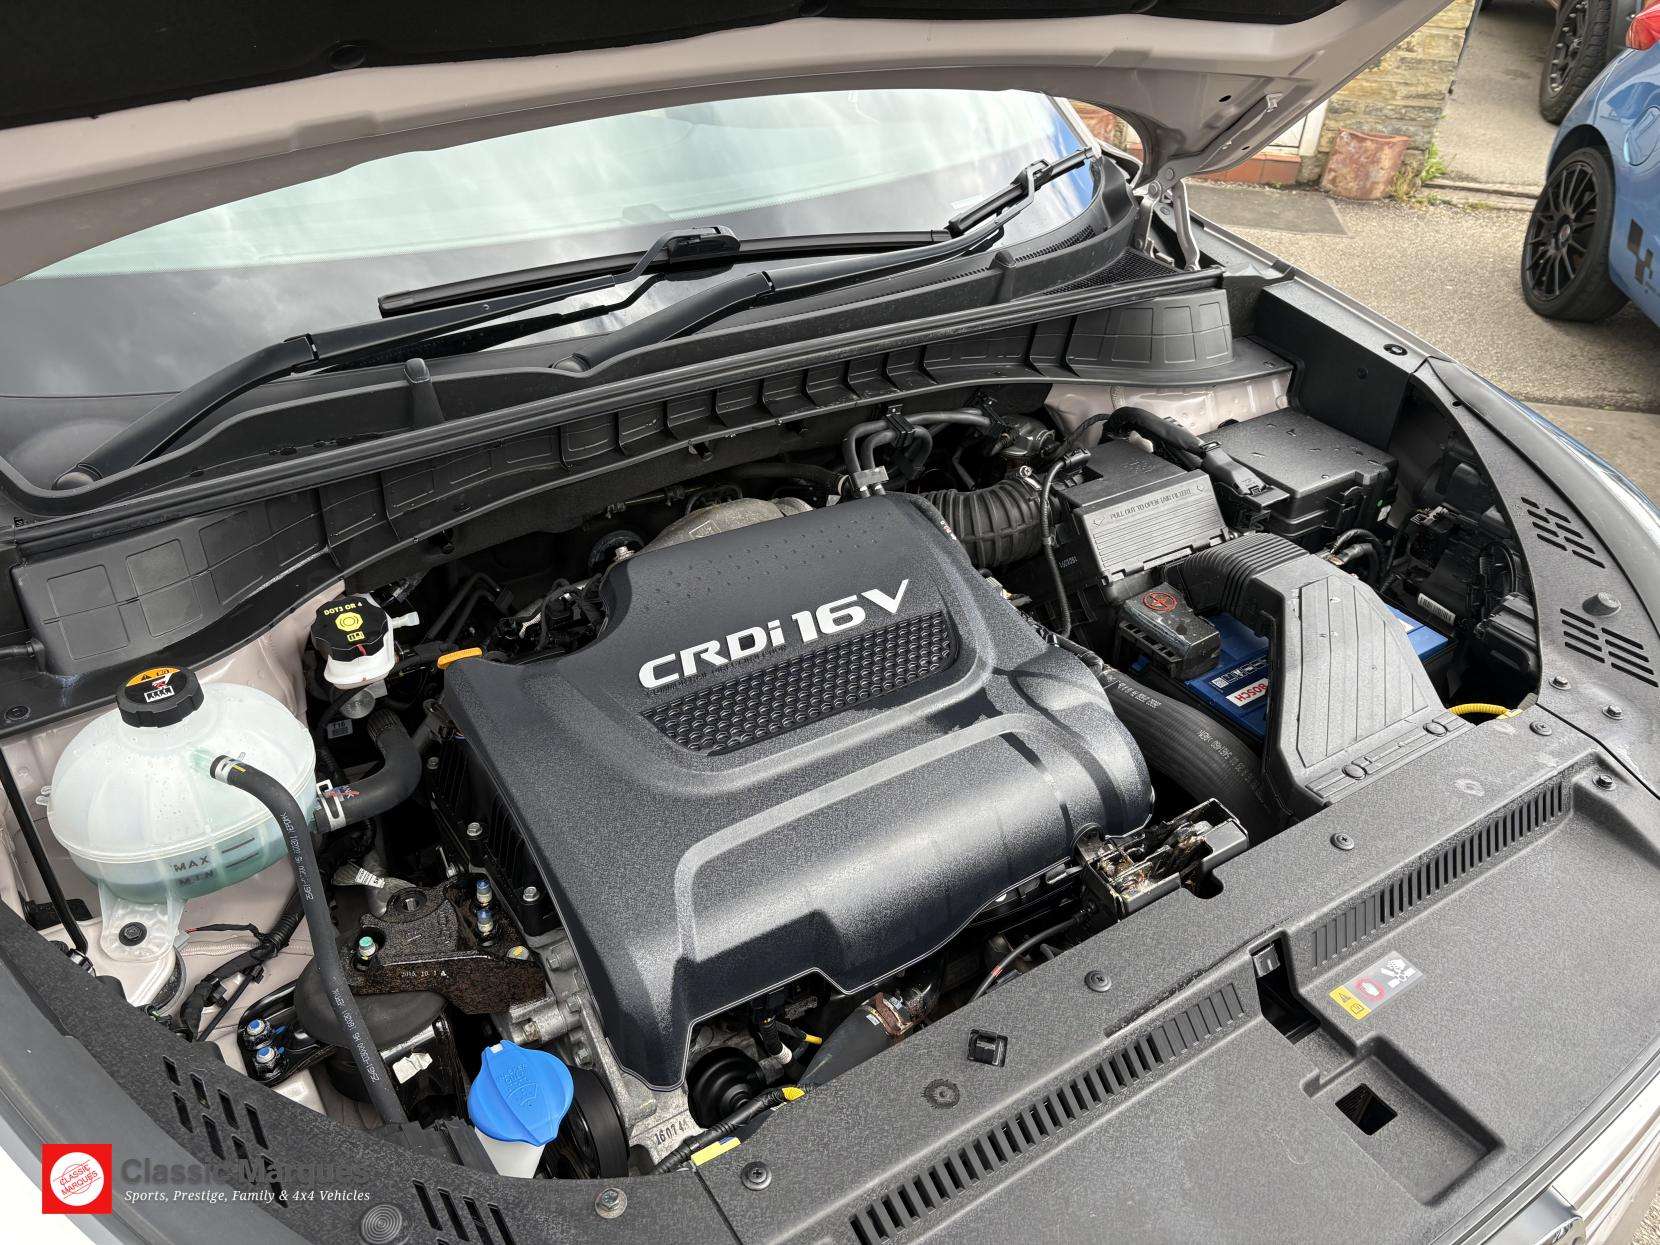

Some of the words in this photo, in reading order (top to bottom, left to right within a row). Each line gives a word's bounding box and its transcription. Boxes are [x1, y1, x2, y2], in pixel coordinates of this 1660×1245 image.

[323, 606, 344, 617] DOT3
[638, 619, 786, 690] CRDi
[791, 578, 909, 644] 16V
[1234, 683, 1267, 702] BOSCH
[173, 855, 209, 872] MAX
[178, 869, 214, 885] MIN
